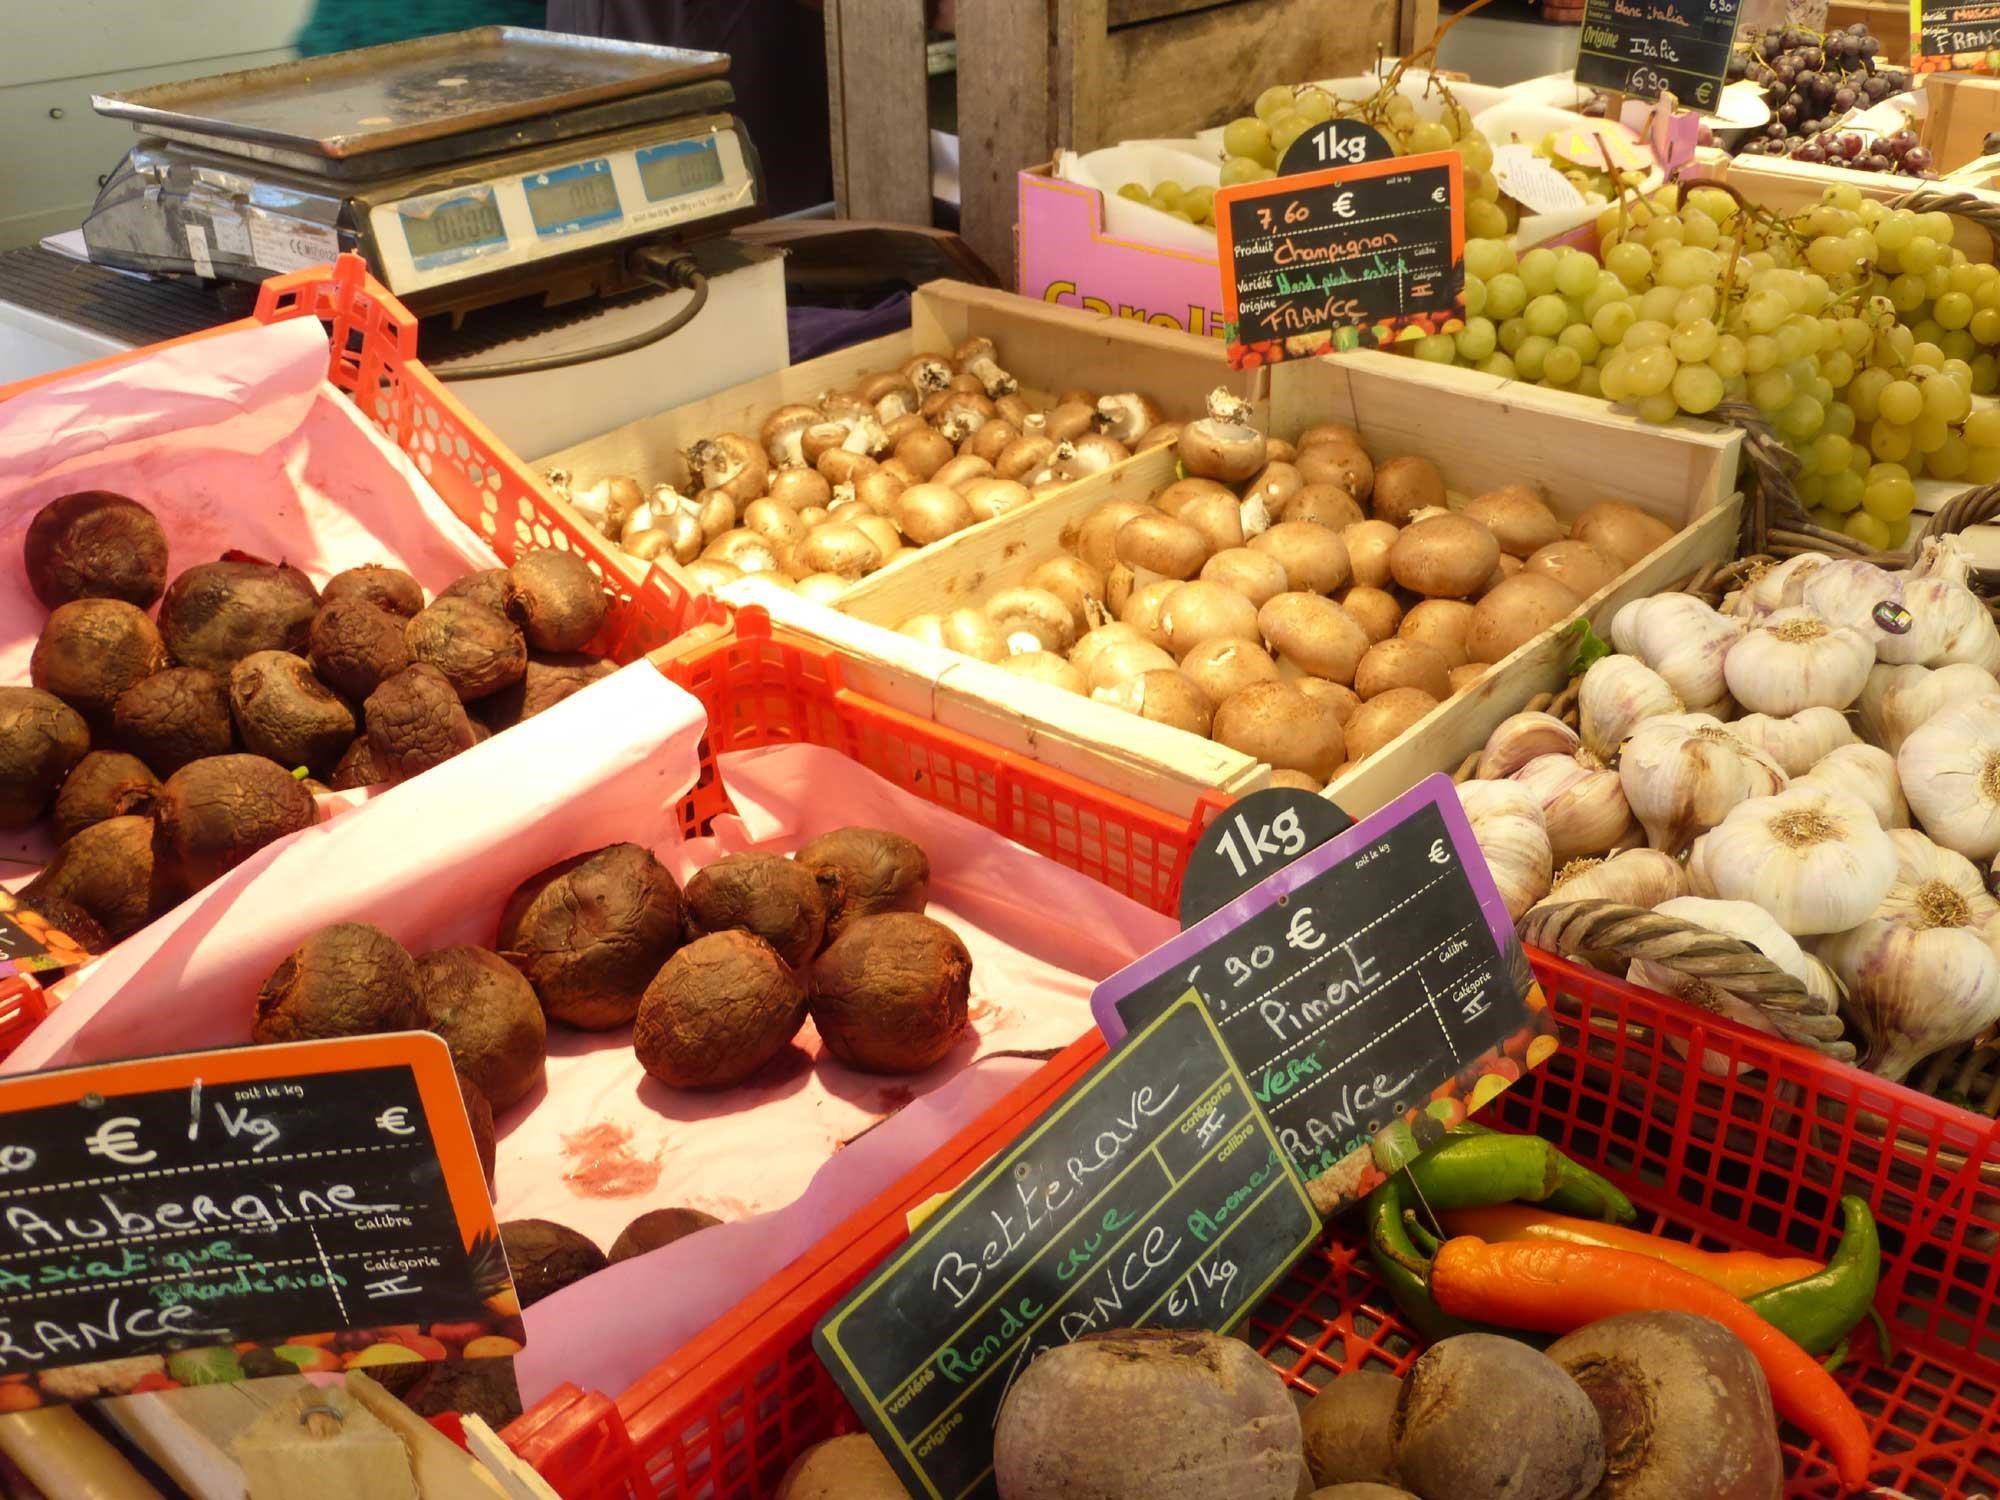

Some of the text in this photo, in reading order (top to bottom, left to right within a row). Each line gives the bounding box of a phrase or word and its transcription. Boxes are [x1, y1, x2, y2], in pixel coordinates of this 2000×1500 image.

[1583, 25, 1620, 49] Origine
[1695, 82, 1713, 104] €
[1312, 126, 1366, 163] 1kg
[1332, 192, 1357, 218] €
[1431, 186, 1446, 203] €
[1235, 233, 1398, 264] Produit Champignon
[1237, 274, 1273, 293] Variété
[1239, 300, 1276, 315] Origine
[1215, 806, 1306, 877] 1kg
[1355, 843, 1391, 869] soit le kg
[1286, 907, 1326, 950] €
[1428, 838, 1450, 864] €
[1438, 940, 1468, 963] Calibre
[1260, 942, 1381, 1040] Piment
[1452, 971, 1492, 1003] Catégorie
[234, 1084, 304, 1101] soit le kg
[1180, 1082, 1232, 1134] catégorie
[85, 1117, 157, 1165] €
[375, 1106, 415, 1135] €
[1218, 1124, 1254, 1162] calibre
[355, 1213, 412, 1230] Calibre
[364, 1256, 441, 1272] Catégorie
[889, 1367, 935, 1414] variété
[937, 1297, 1044, 1384] Ronde
[918, 1412, 963, 1457] origine
